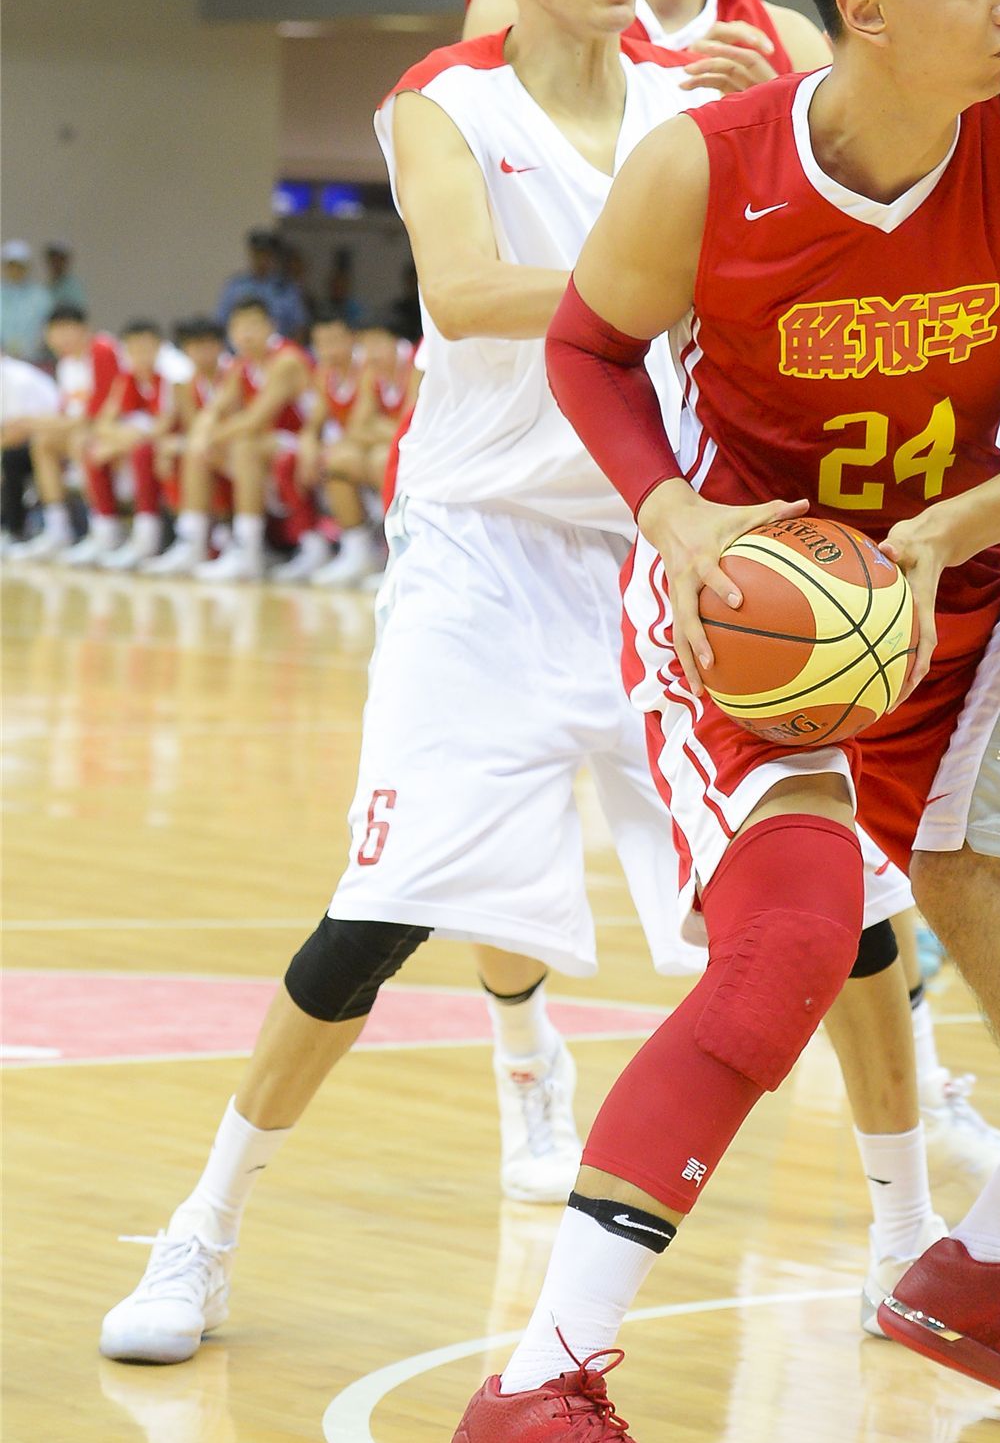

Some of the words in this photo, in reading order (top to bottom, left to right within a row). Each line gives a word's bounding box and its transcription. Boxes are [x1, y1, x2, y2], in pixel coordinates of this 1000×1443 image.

[778, 283, 1000, 379] 解放军
[818, 396, 956, 510] 24
[357, 789, 397, 866] 6
